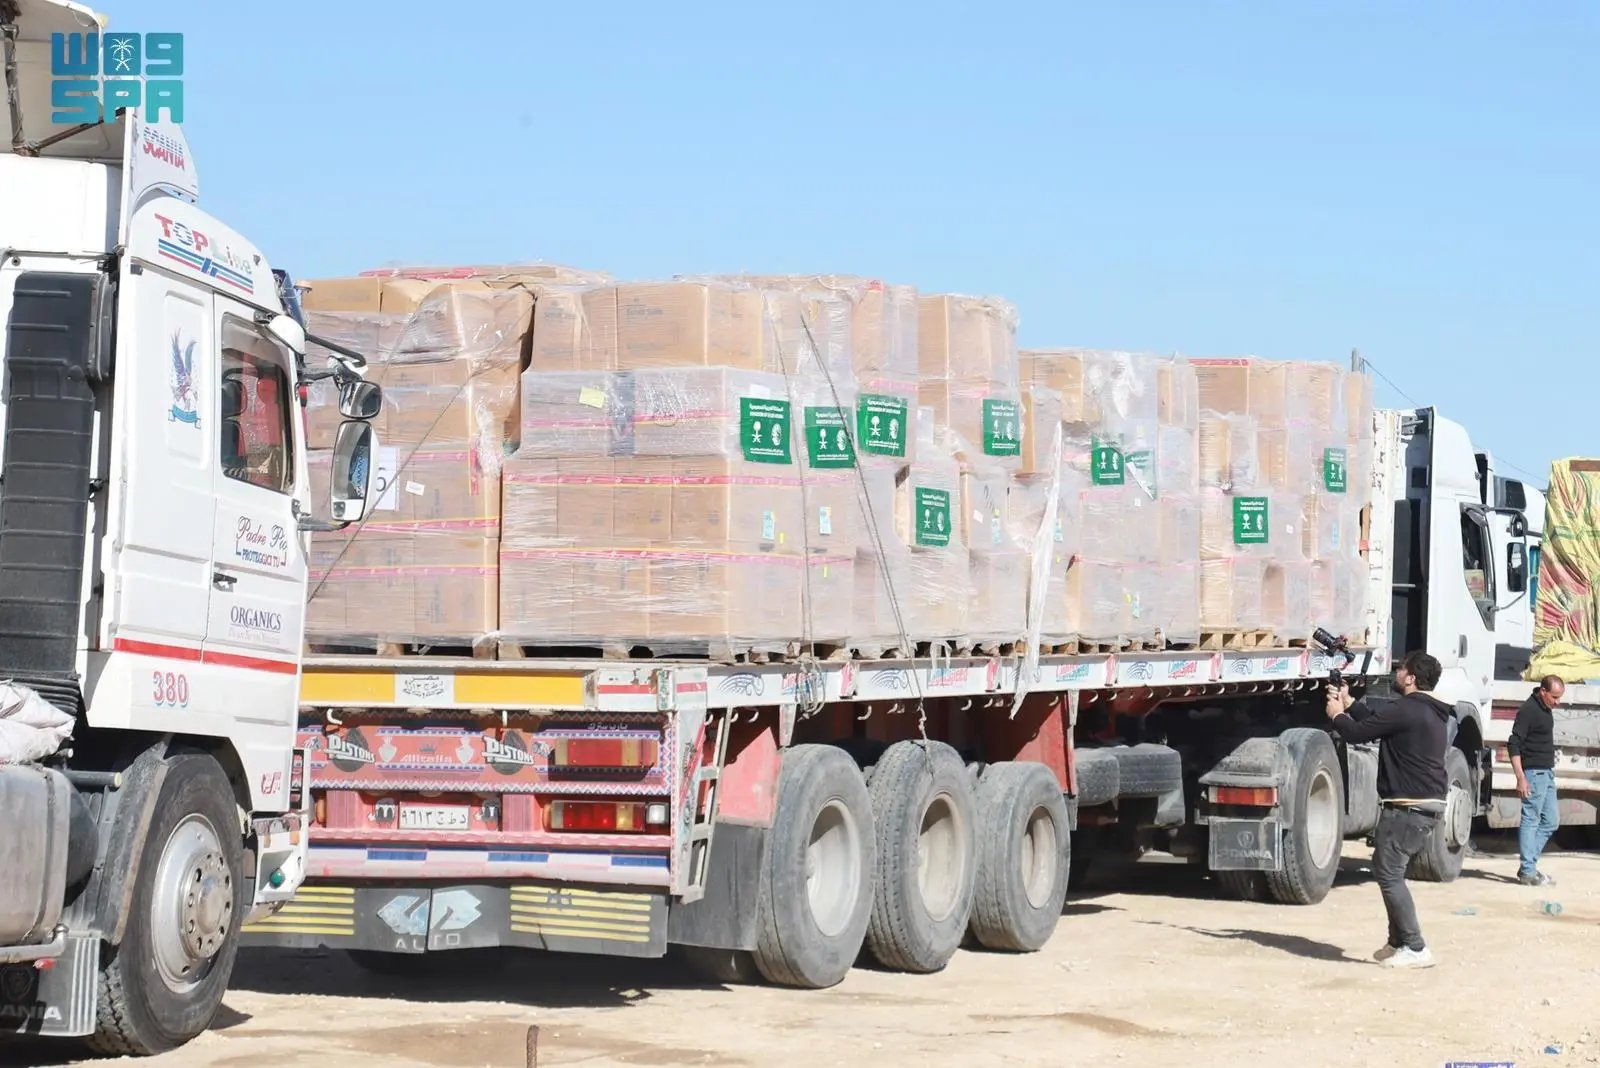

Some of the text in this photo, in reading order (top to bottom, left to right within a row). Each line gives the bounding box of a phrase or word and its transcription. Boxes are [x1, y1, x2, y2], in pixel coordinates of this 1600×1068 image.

[154, 212, 209, 252] TOP
[236, 514, 288, 551] Padre Pio
[230, 605, 281, 631] ORGANICS
[153, 671, 188, 708] 380
[324, 733, 376, 763] PISTONS
[482, 735, 535, 765] PISTONS
[395, 932, 461, 951] AUTO
